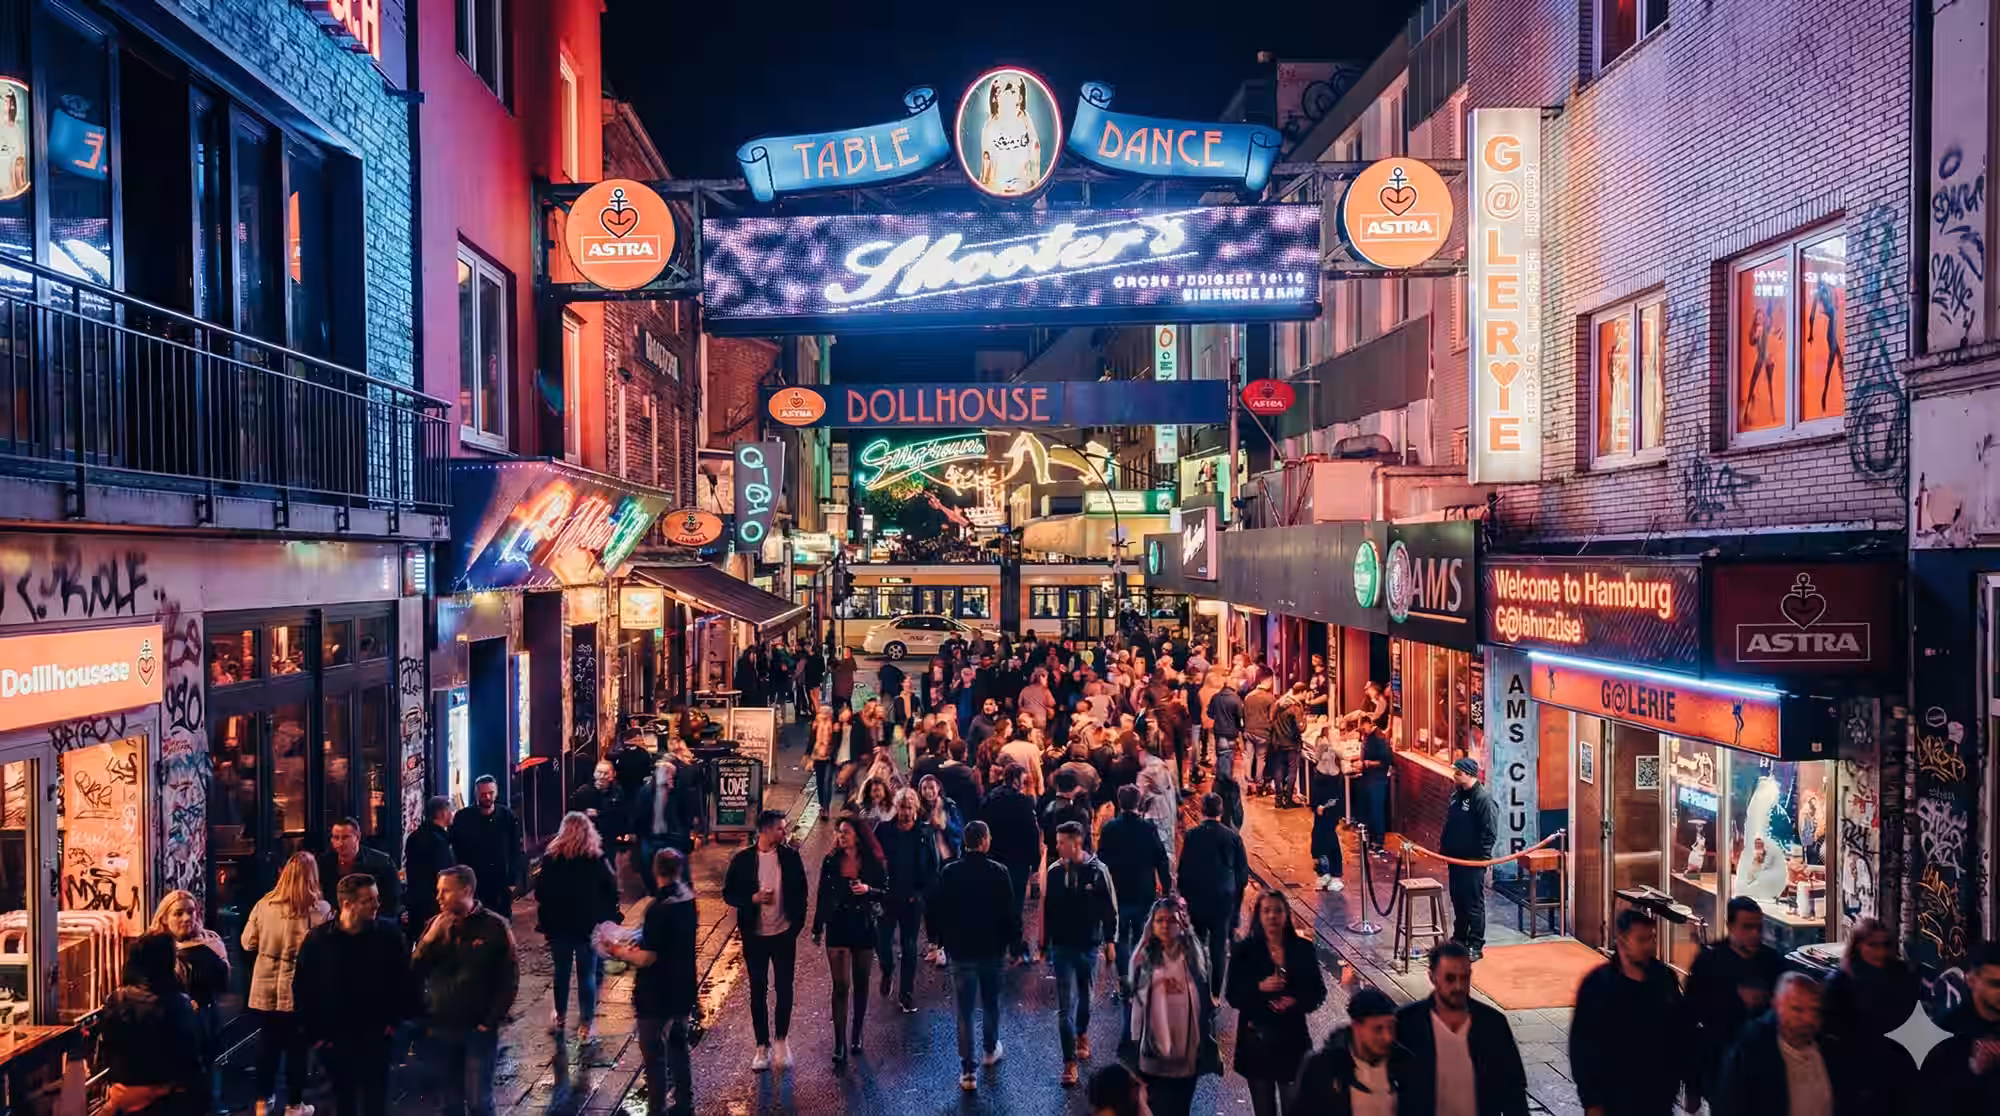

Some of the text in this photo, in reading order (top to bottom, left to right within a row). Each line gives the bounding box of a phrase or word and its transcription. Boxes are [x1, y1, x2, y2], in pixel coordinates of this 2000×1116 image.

[793, 127, 920, 179] TABLE
[1098, 120, 1225, 168] DANCE
[588, 242, 654, 256] ASTRA
[1367, 219, 1433, 234] ASTRA
[847, 387, 1050, 423] DOLLHOUSE
[1408, 557, 1463, 612] AMS
[1494, 568, 1672, 620] Welcome to Hamburg
[1746, 632, 1861, 653] ASTRA
[1507, 673, 1526, 743] AMS
